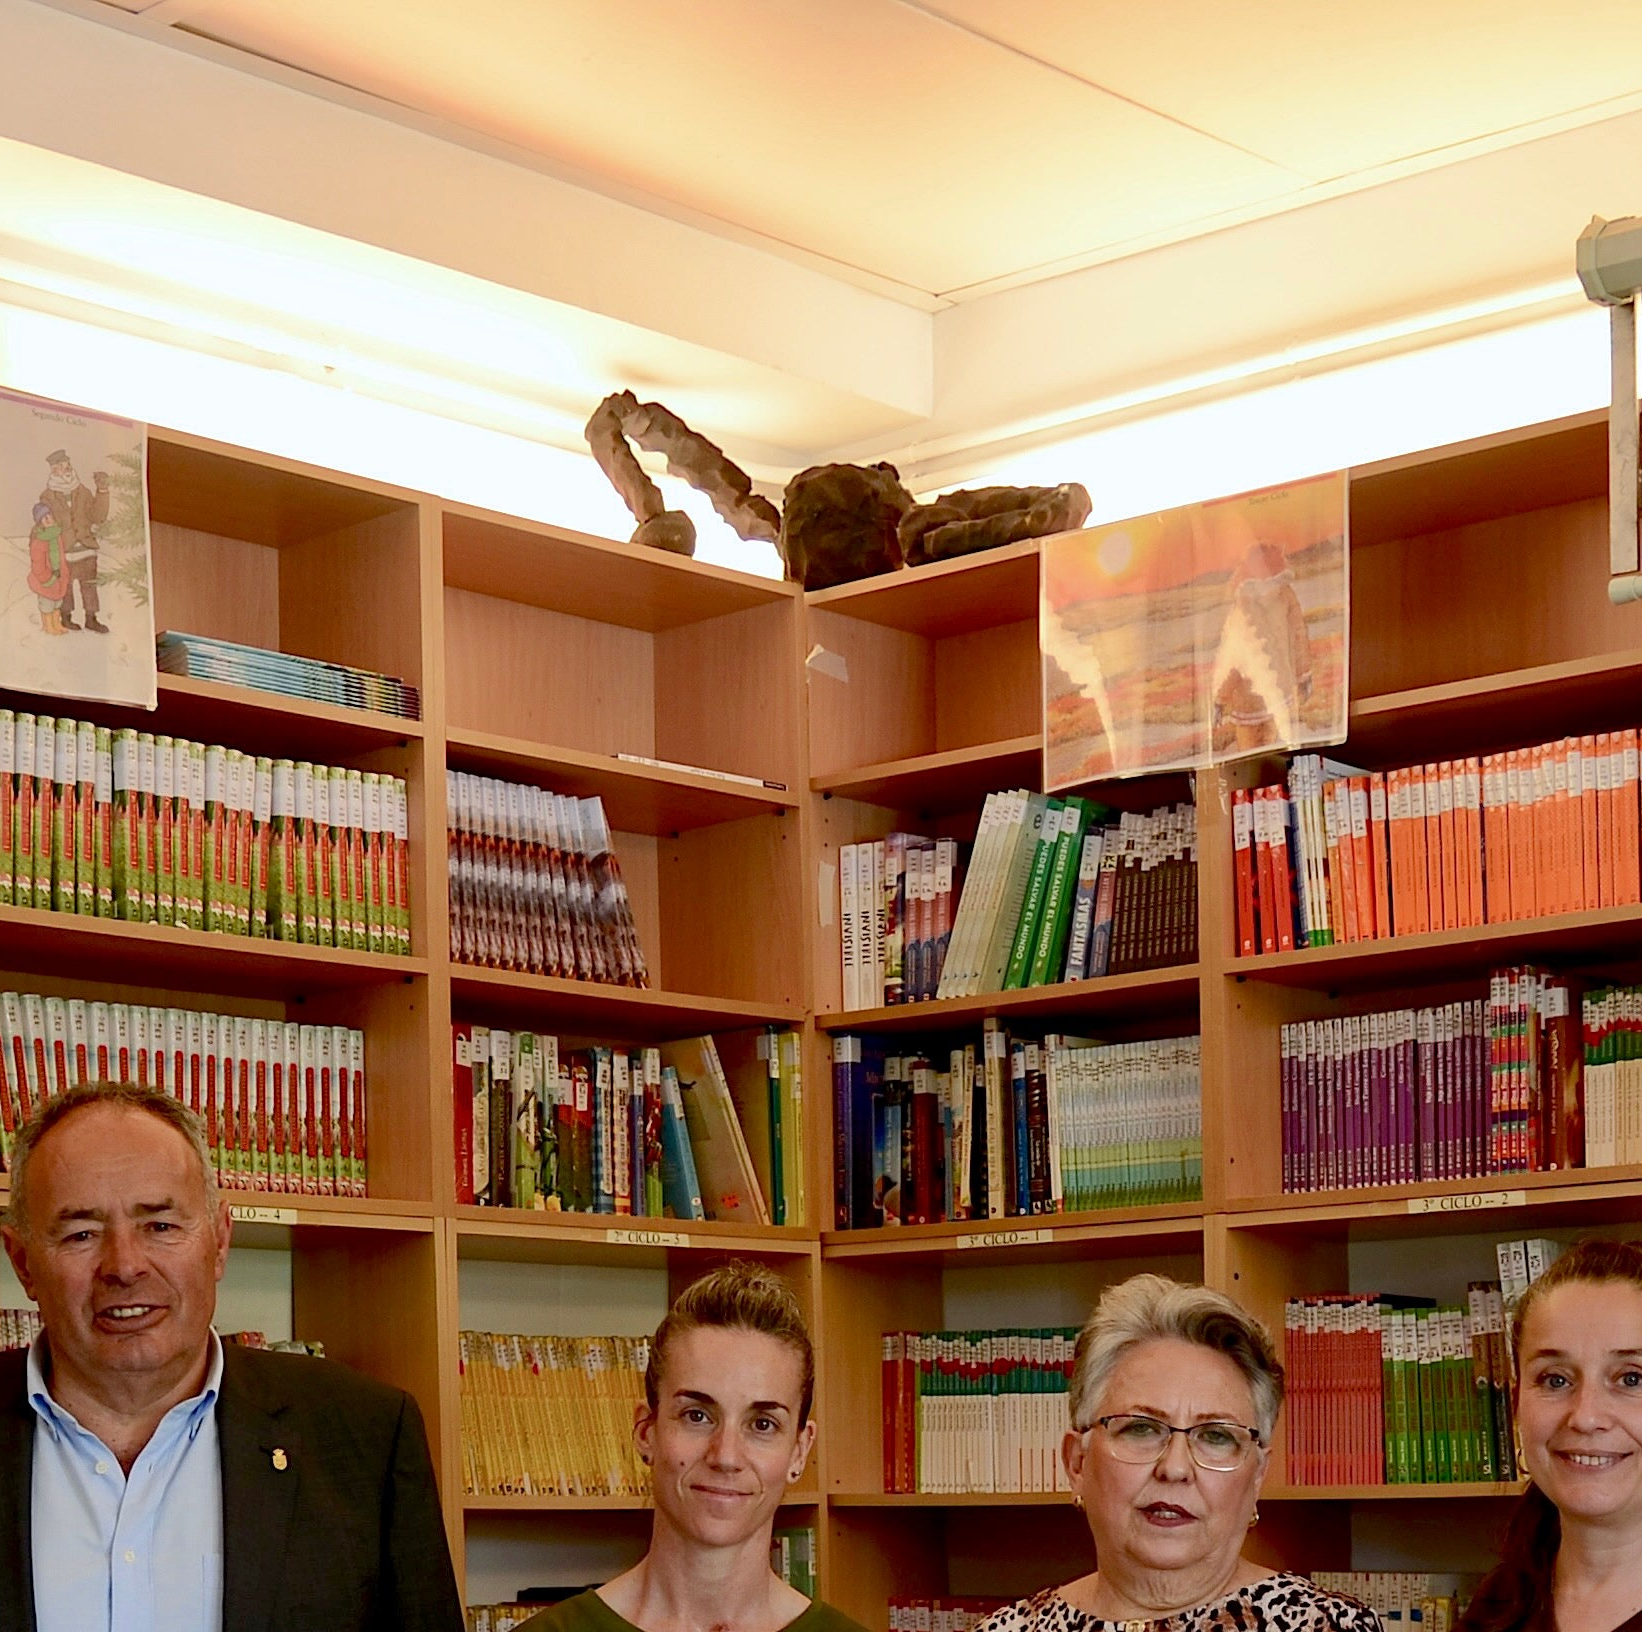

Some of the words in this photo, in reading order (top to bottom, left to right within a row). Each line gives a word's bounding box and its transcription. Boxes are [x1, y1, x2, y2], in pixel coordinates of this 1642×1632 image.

[1035, 841, 1051, 875] PUEDES
[1055, 836, 1070, 872] PUEDES
[1028, 876, 1046, 910] SALVAR
[1048, 873, 1063, 907] SALVAR
[1024, 911, 1033, 922] EL
[1046, 909, 1055, 920] EL
[1069, 897, 1092, 966] FANTASMAS
[1015, 924, 1030, 960] MUNDO
[1038, 921, 1052, 958] MUNDO
[230, 1206, 257, 1220] CLO
[273, 1209, 281, 1220] 4
[1440, 1195, 1482, 1210] CICLO
[1501, 1193, 1509, 1206] 2
[628, 1231, 661, 1244] CICLO
[983, 1231, 1018, 1246] CICLO
[1035, 1231, 1040, 1242] 1
